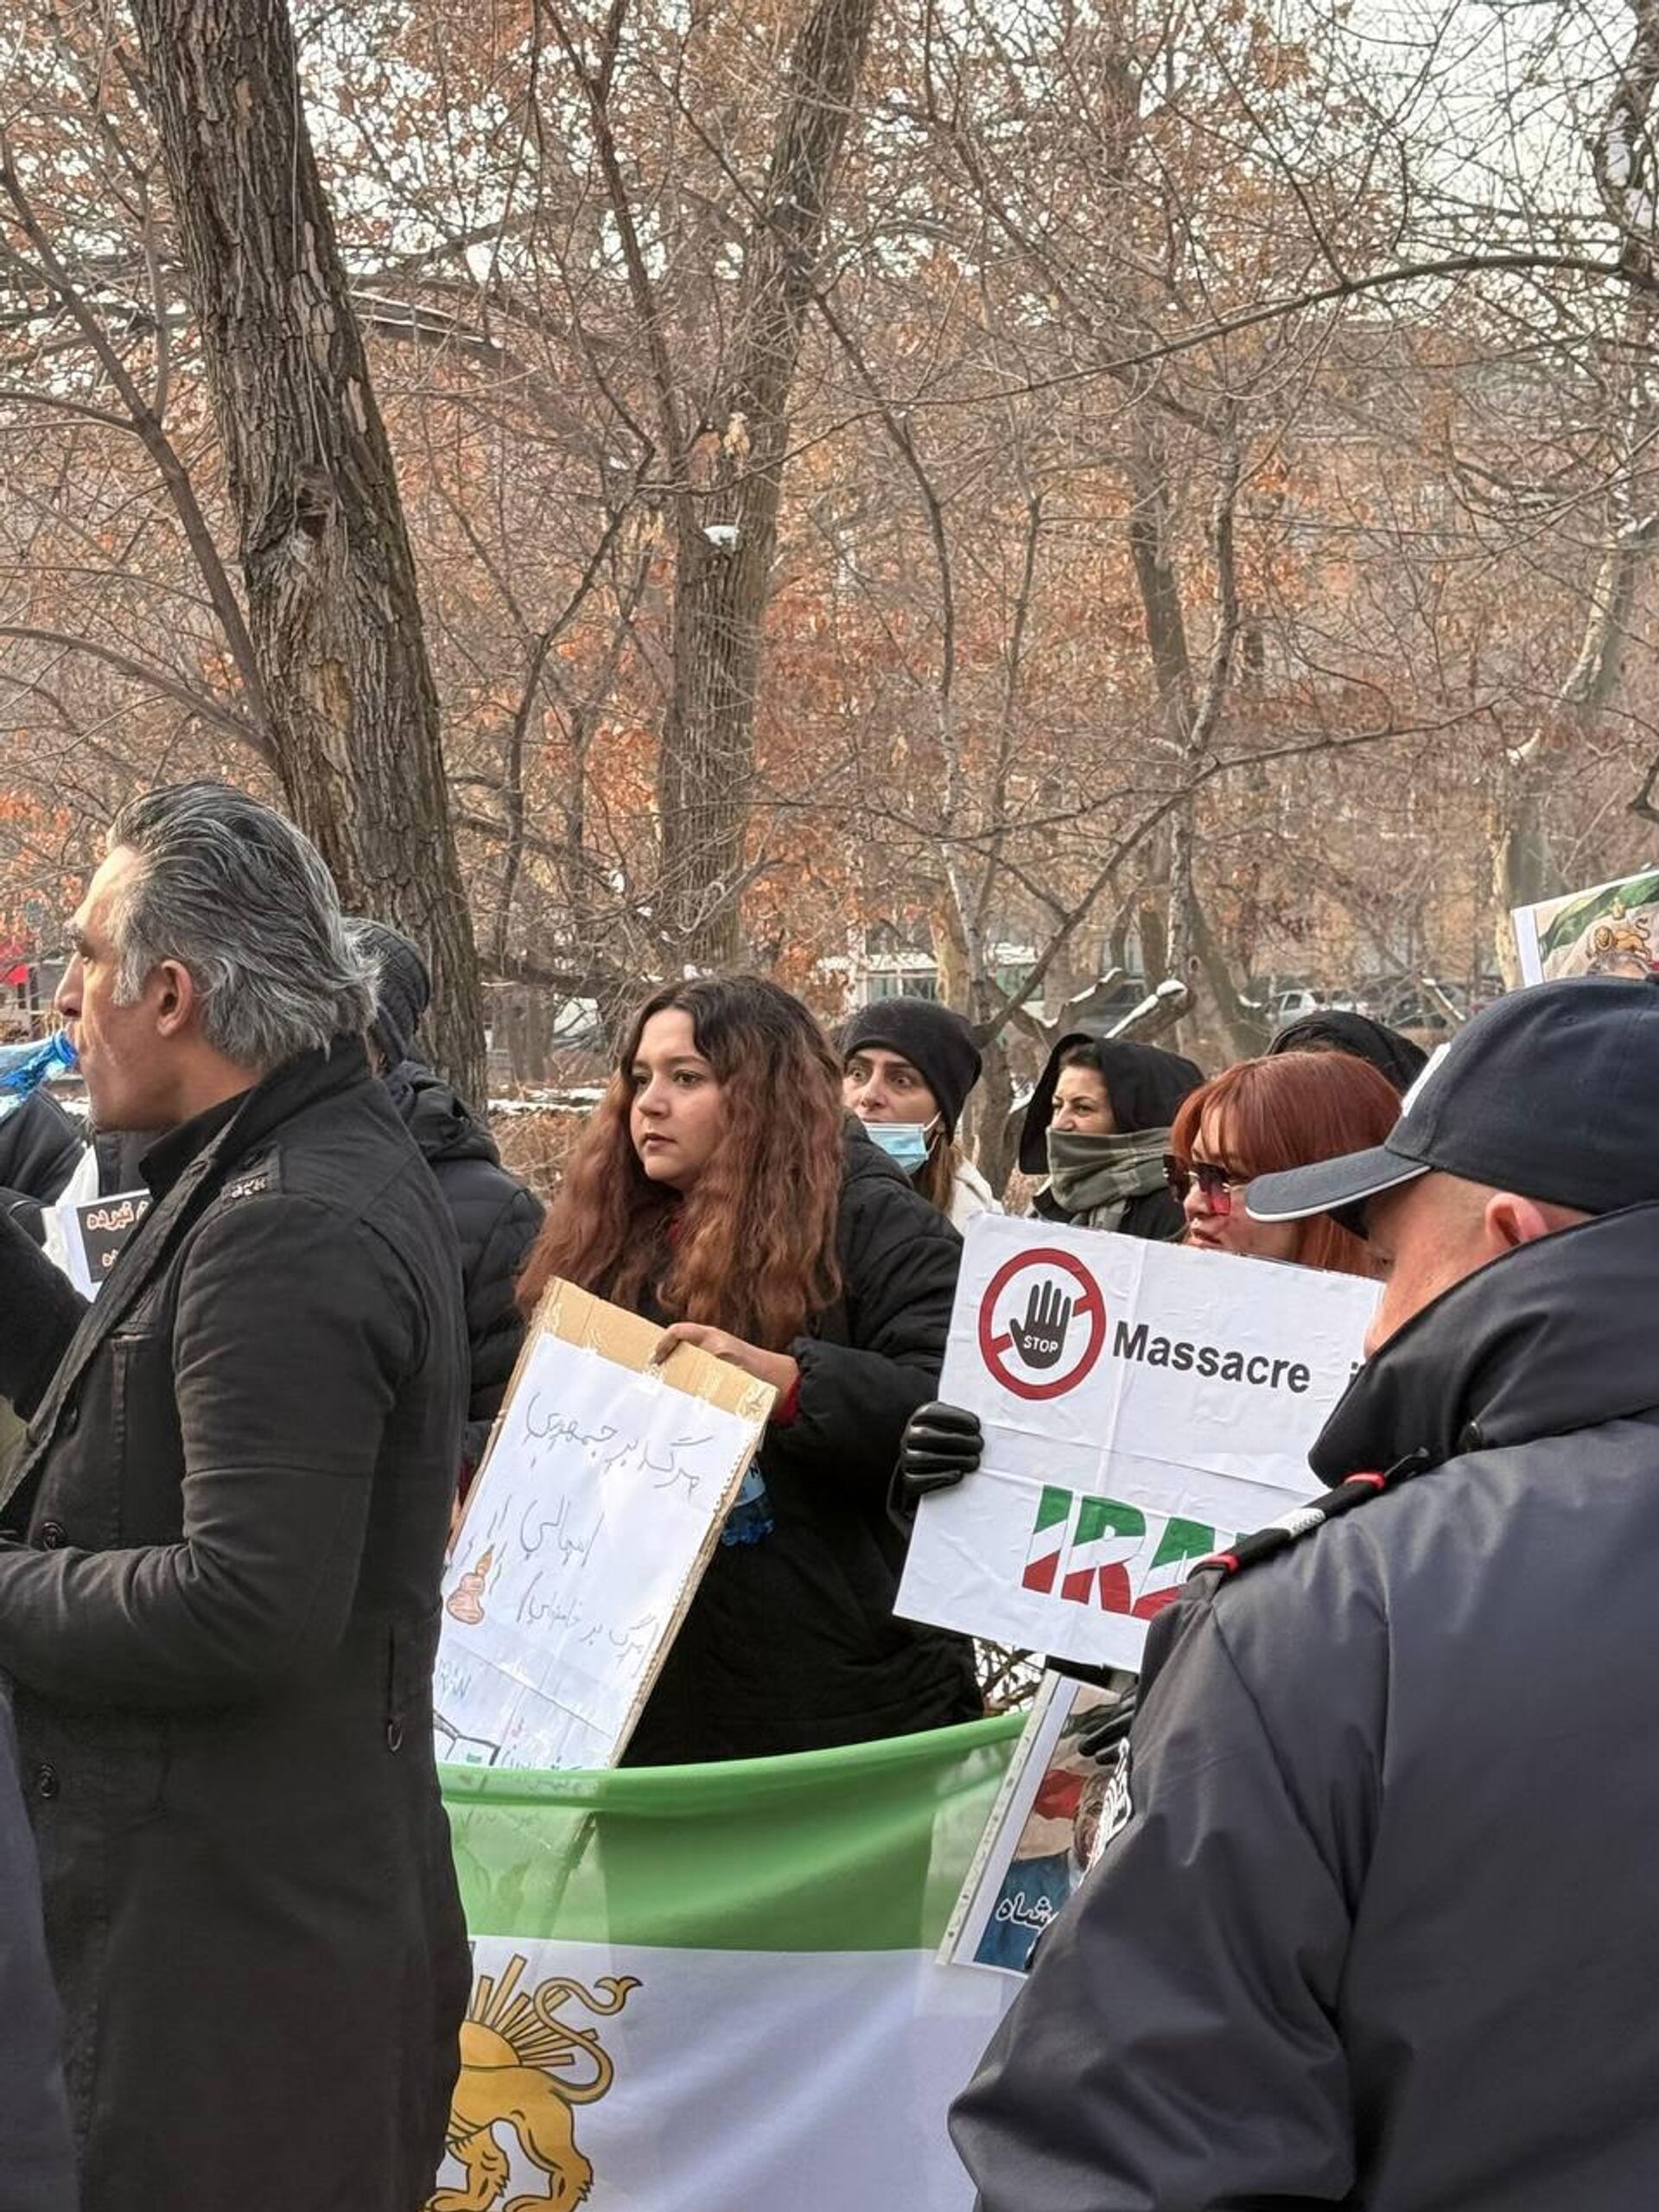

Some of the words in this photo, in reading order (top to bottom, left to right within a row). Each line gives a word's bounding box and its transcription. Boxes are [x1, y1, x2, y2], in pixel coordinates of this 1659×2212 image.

[1023, 1334, 1058, 1353] STOP
[1113, 1321, 1311, 1393] Massacre
[604, 1439, 639, 1475] بر
[639, 1434, 716, 1501] مرگ
[1021, 1485, 1249, 1620] IRA
[578, 1623, 604, 1646] بر
